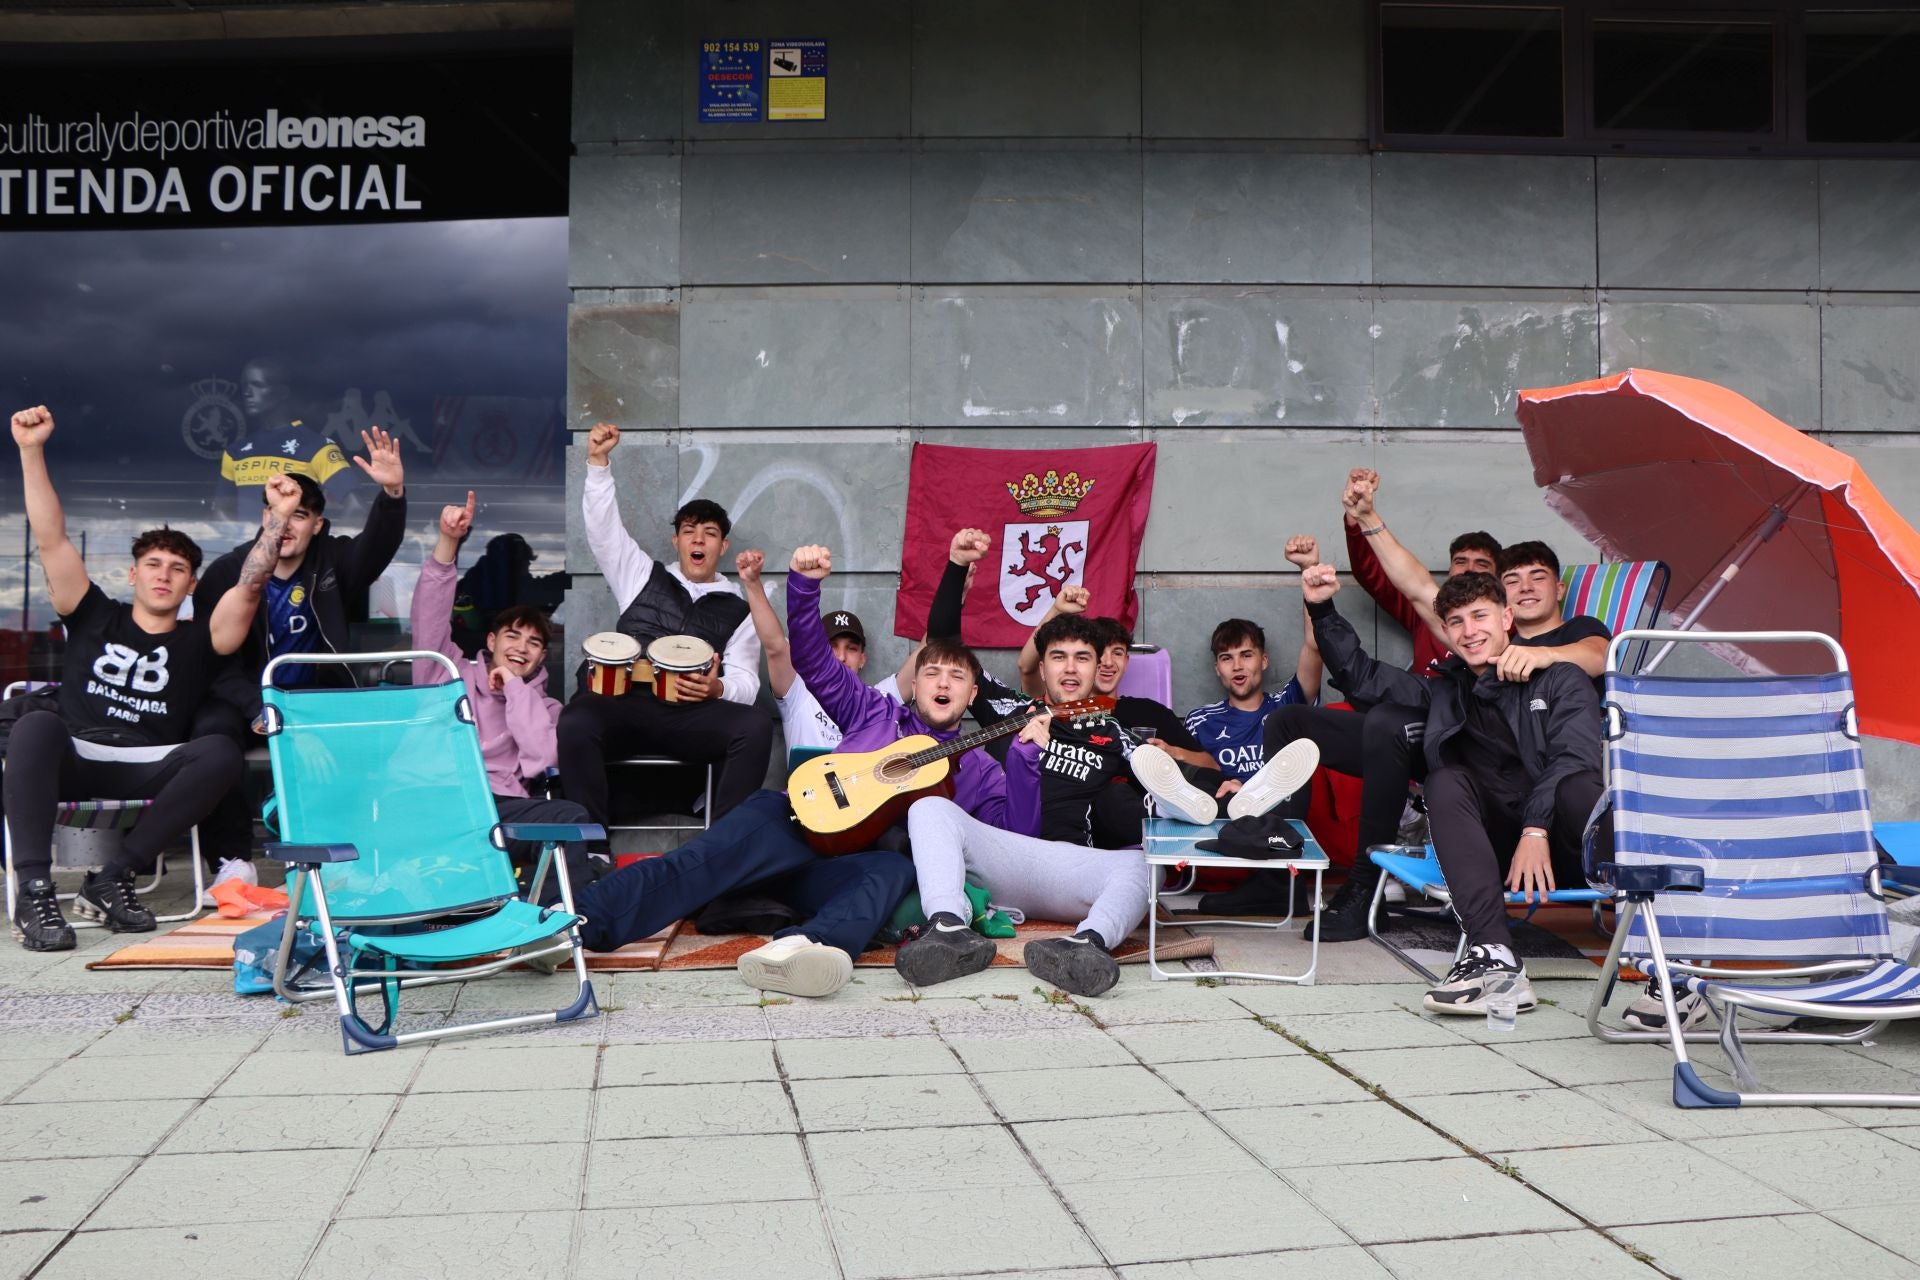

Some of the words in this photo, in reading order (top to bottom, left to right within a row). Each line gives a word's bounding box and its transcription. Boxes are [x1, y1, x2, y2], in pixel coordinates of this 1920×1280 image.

[704, 42, 720, 53] 902
[724, 42, 740, 53] 154
[743, 41, 760, 52] 539
[0, 167, 191, 214] TIENDA
[210, 164, 422, 212] OFICIAL
[835, 614, 849, 626] NY
[107, 706, 140, 723] PARIS
[1045, 754, 1091, 782] BETTER
